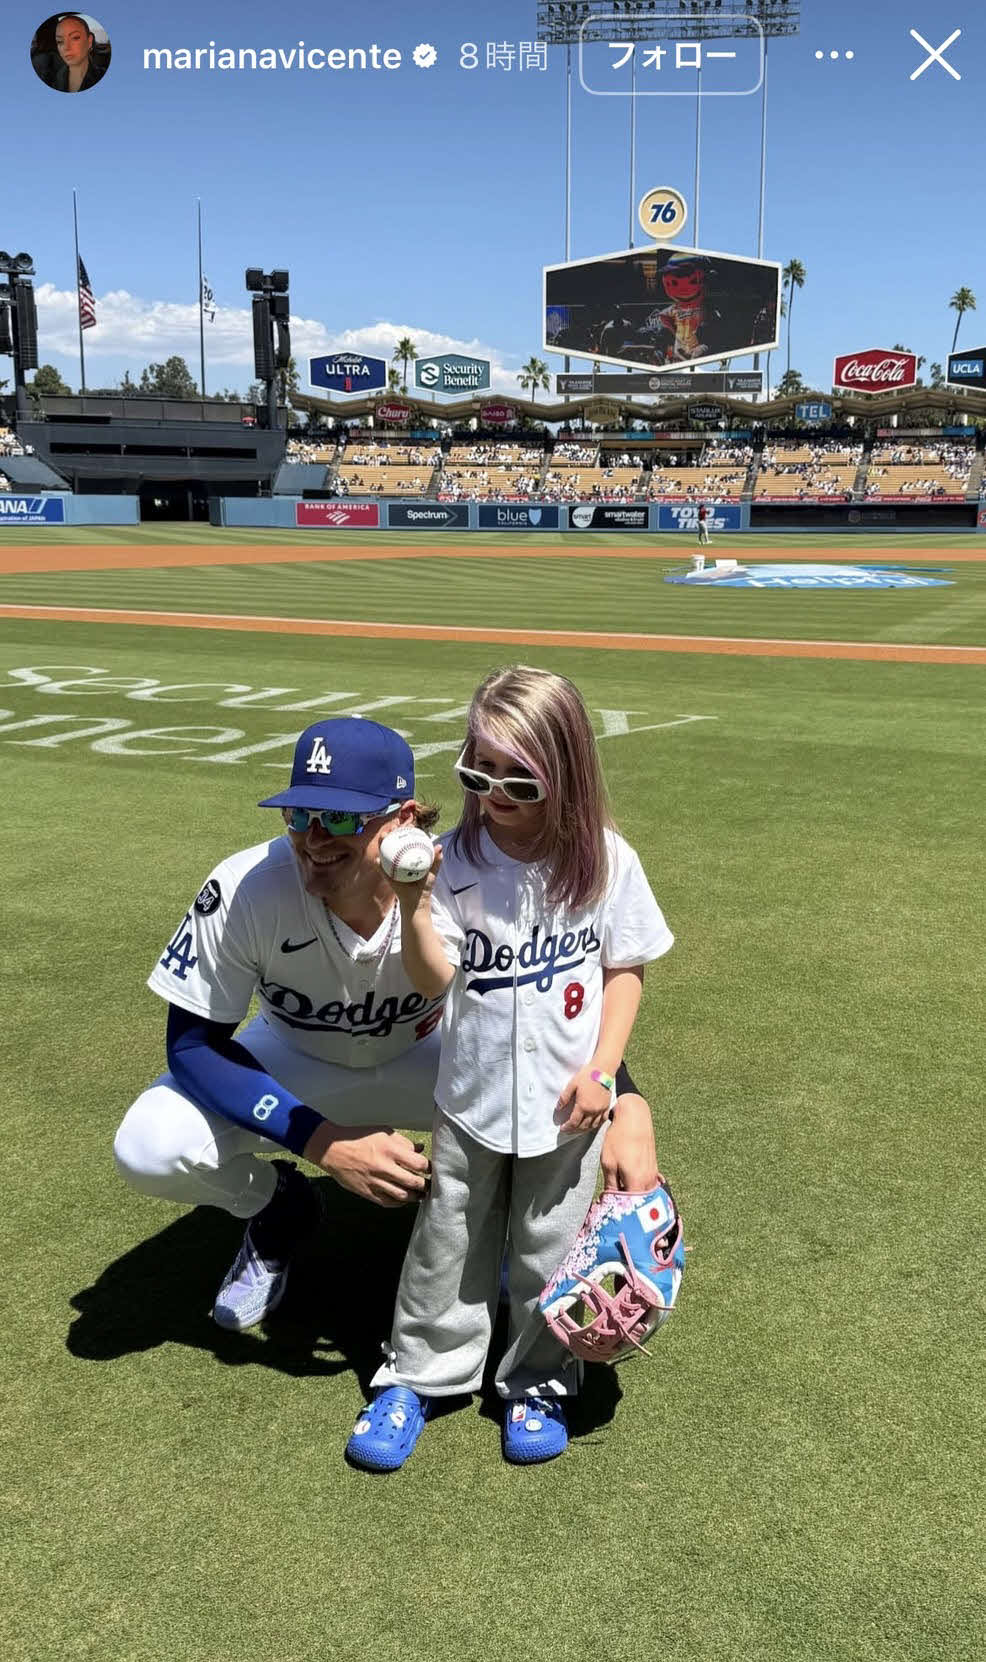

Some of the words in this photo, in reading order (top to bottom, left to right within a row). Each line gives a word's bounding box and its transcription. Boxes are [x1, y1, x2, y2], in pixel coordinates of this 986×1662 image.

[649, 201, 677, 224] 76
[326, 363, 370, 376] ULTRA
[443, 363, 484, 377] Security
[841, 358, 910, 382] Coca-Cola
[953, 363, 980, 374] UCLA
[444, 375, 478, 386] Benefit
[377, 406, 409, 418] Churu
[800, 405, 827, 418] TEL
[407, 510, 448, 520] Spectrum
[497, 508, 528, 521] blue
[677, 518, 727, 529] TIRES
[306, 737, 333, 775] LA
[197, 888, 215, 912] 34
[160, 912, 199, 981] LA
[462, 924, 602, 993] Dodgers
[259, 977, 430, 1037] Dodge
[563, 982, 586, 1020] 8
[252, 1094, 280, 1122] 8
